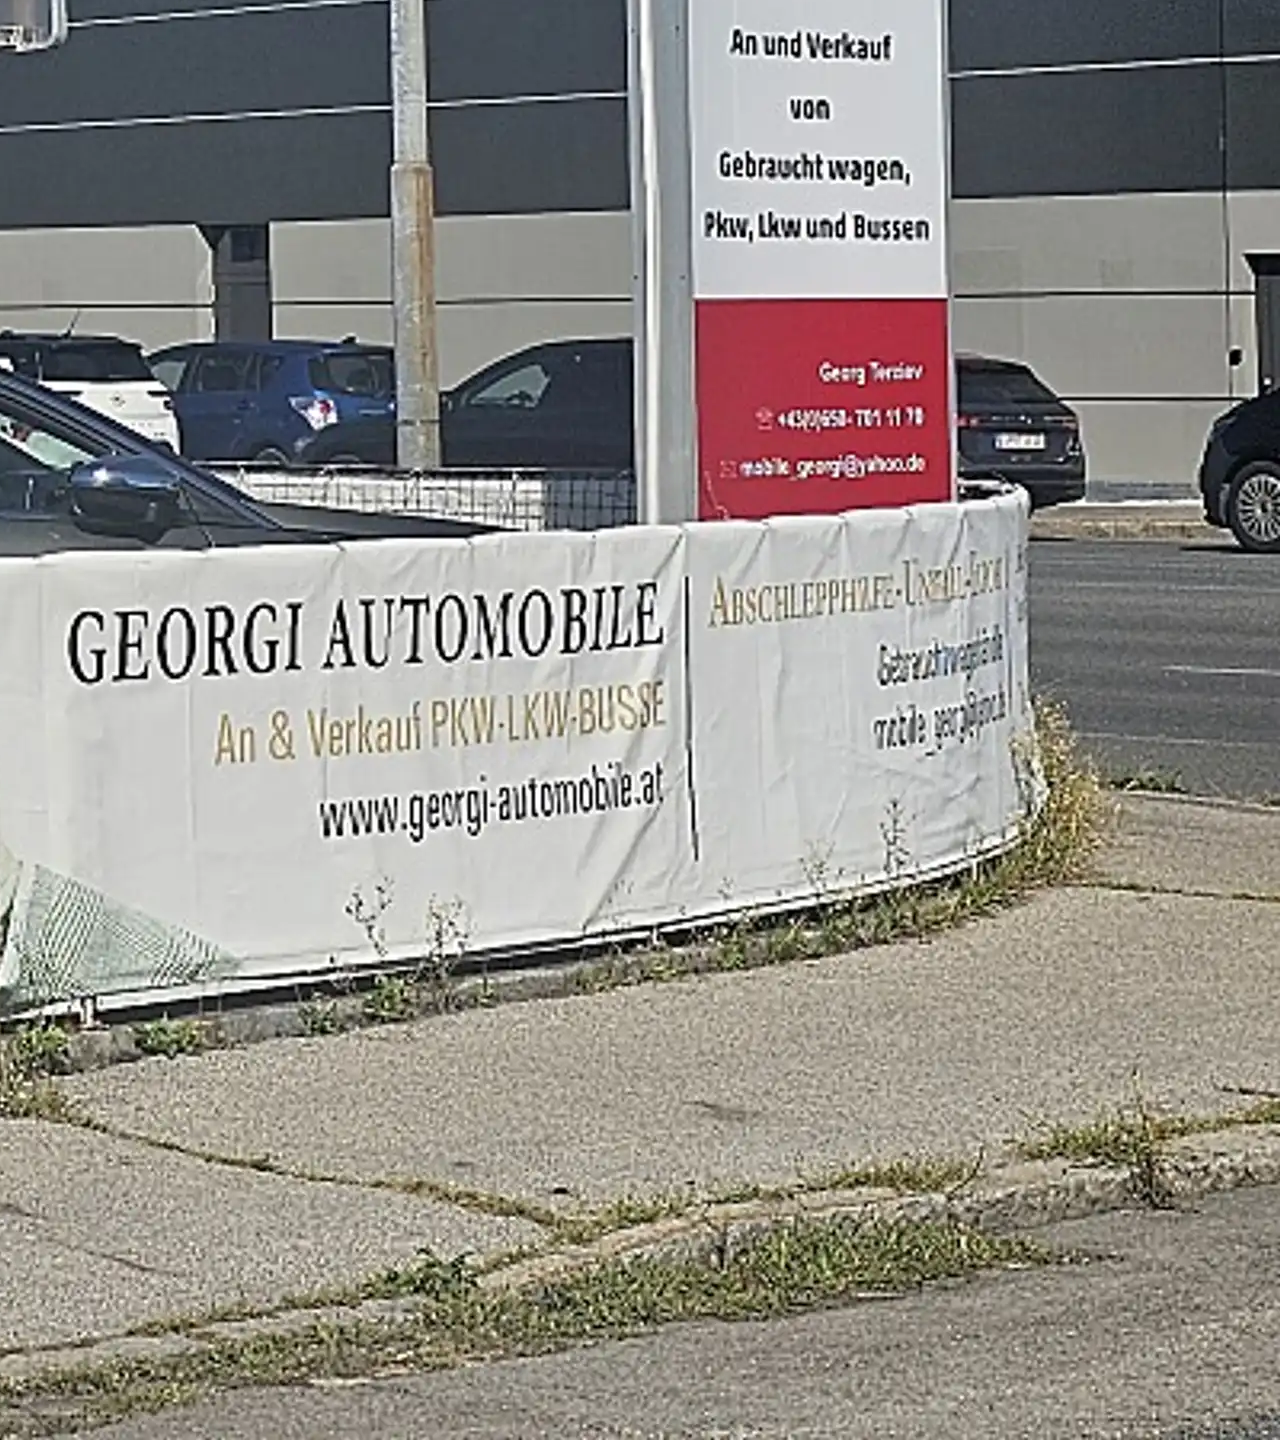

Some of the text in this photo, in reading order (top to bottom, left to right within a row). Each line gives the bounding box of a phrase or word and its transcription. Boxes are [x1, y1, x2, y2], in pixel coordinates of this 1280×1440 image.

[730, 30, 892, 61] An und Verkauf
[790, 97, 831, 121] von
[719, 151, 911, 187] Gebraucht wagen,
[704, 212, 930, 244] Pkw, Lkw und Bussen
[819, 361, 865, 386] Georg
[68, 581, 665, 685] GEORGI AUTOMOBILE
[214, 680, 667, 766] An & Verkauf PKW-LKW-BUSSE
[318, 762, 666, 844] www.georgi-automobile.at
